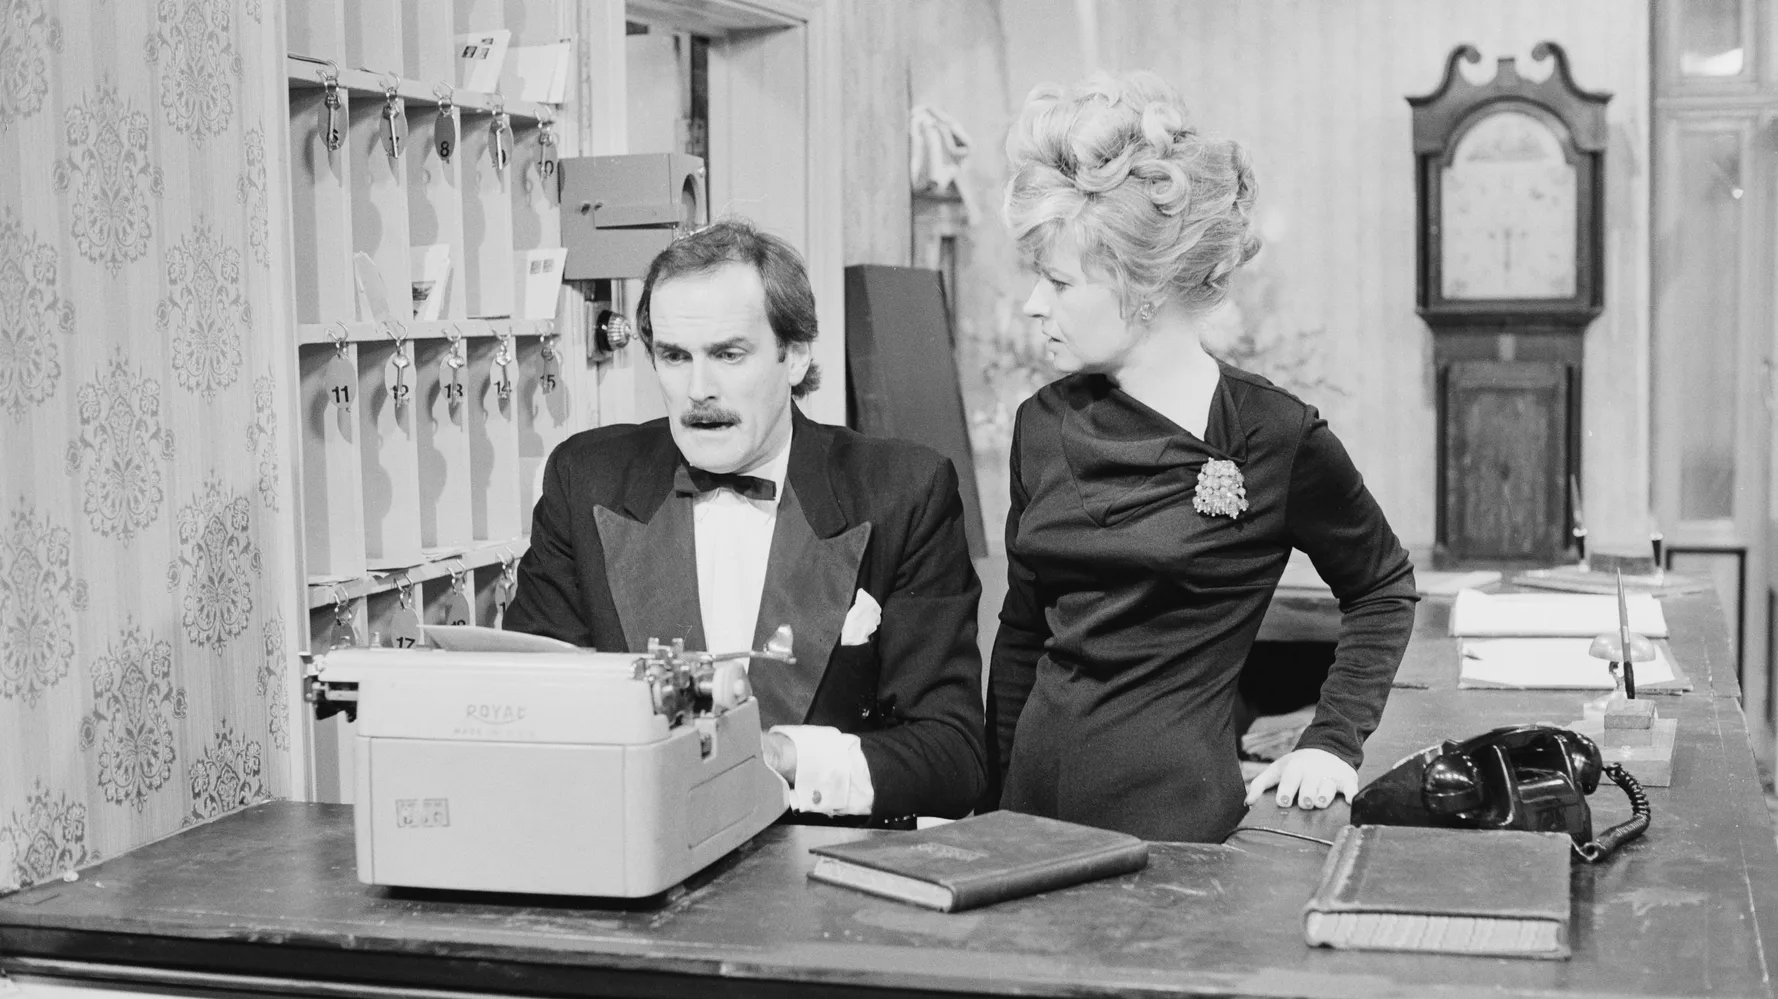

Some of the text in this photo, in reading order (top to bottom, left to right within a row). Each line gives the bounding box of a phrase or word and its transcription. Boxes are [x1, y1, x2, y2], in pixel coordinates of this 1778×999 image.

[440, 141, 450, 157] 8
[332, 386, 349, 403] 11
[444, 383, 463, 400] 13
[396, 637, 416, 649] 17
